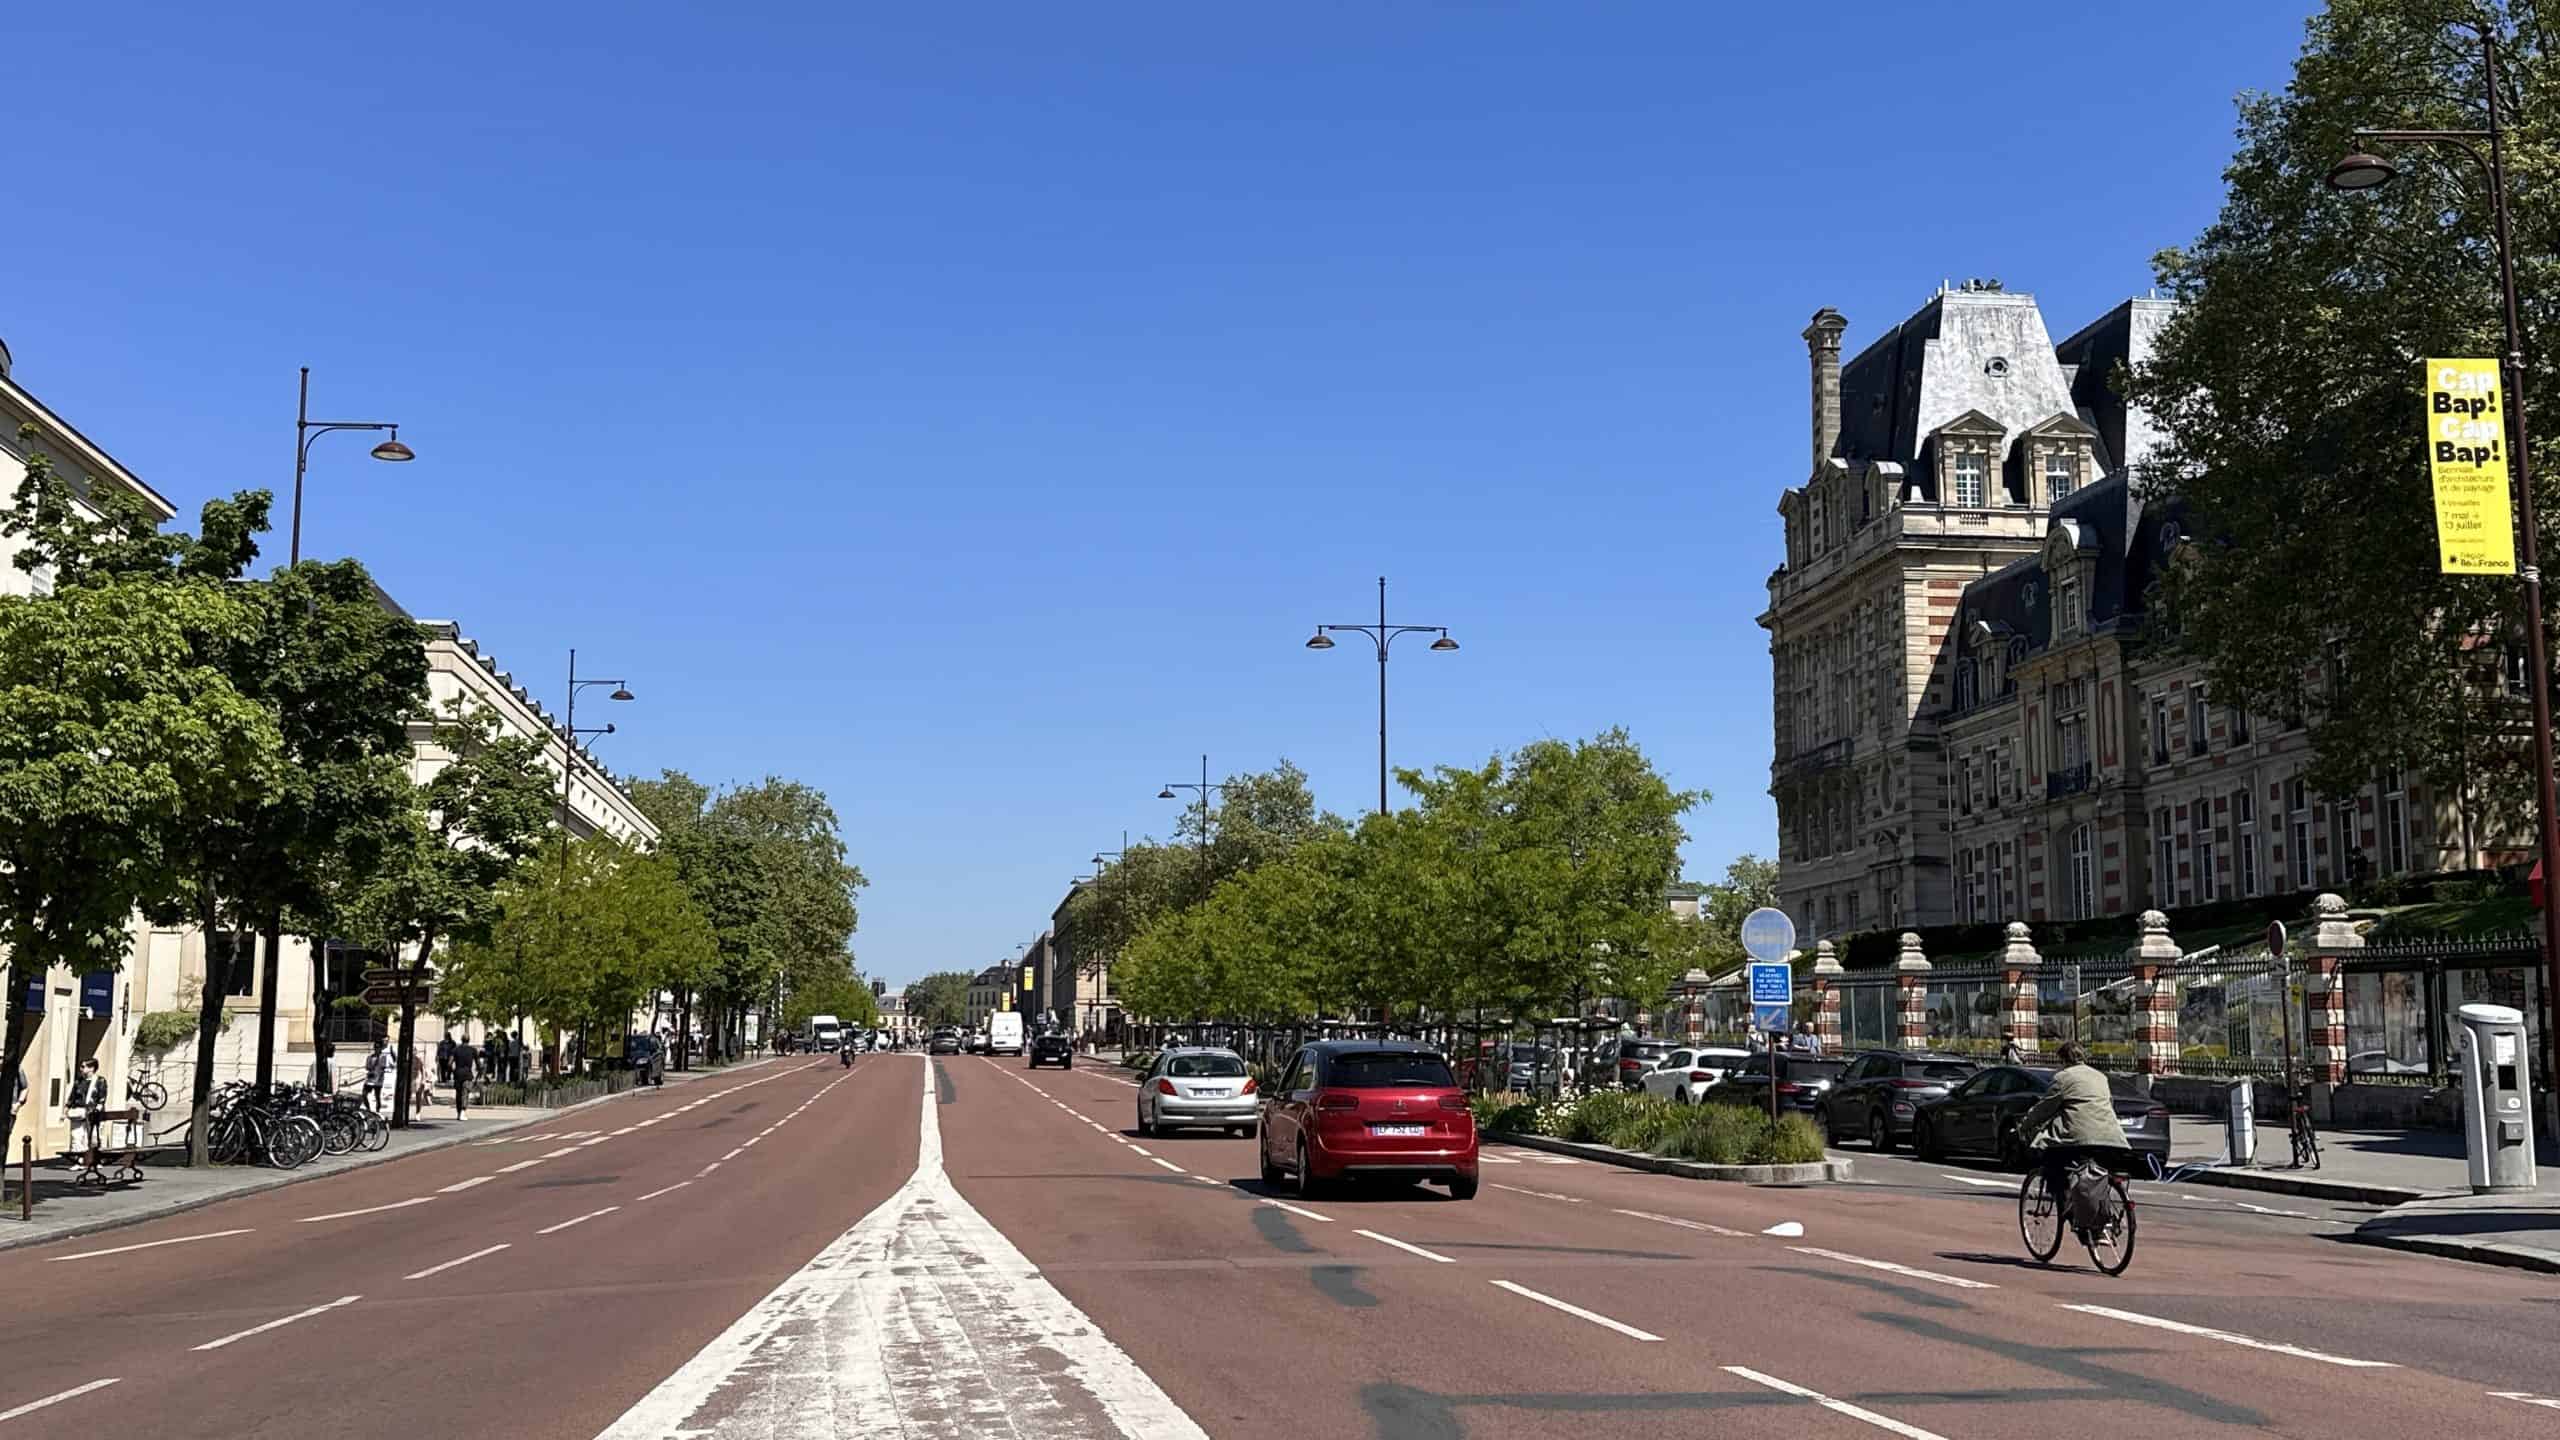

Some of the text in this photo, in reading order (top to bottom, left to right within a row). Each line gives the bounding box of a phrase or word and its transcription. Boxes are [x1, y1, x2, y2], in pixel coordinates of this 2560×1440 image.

[2438, 367, 2495, 394] Cap
[2433, 391, 2496, 419] Bap!
[2440, 417, 2498, 443] Cap
[2436, 440, 2500, 468] Bap!
